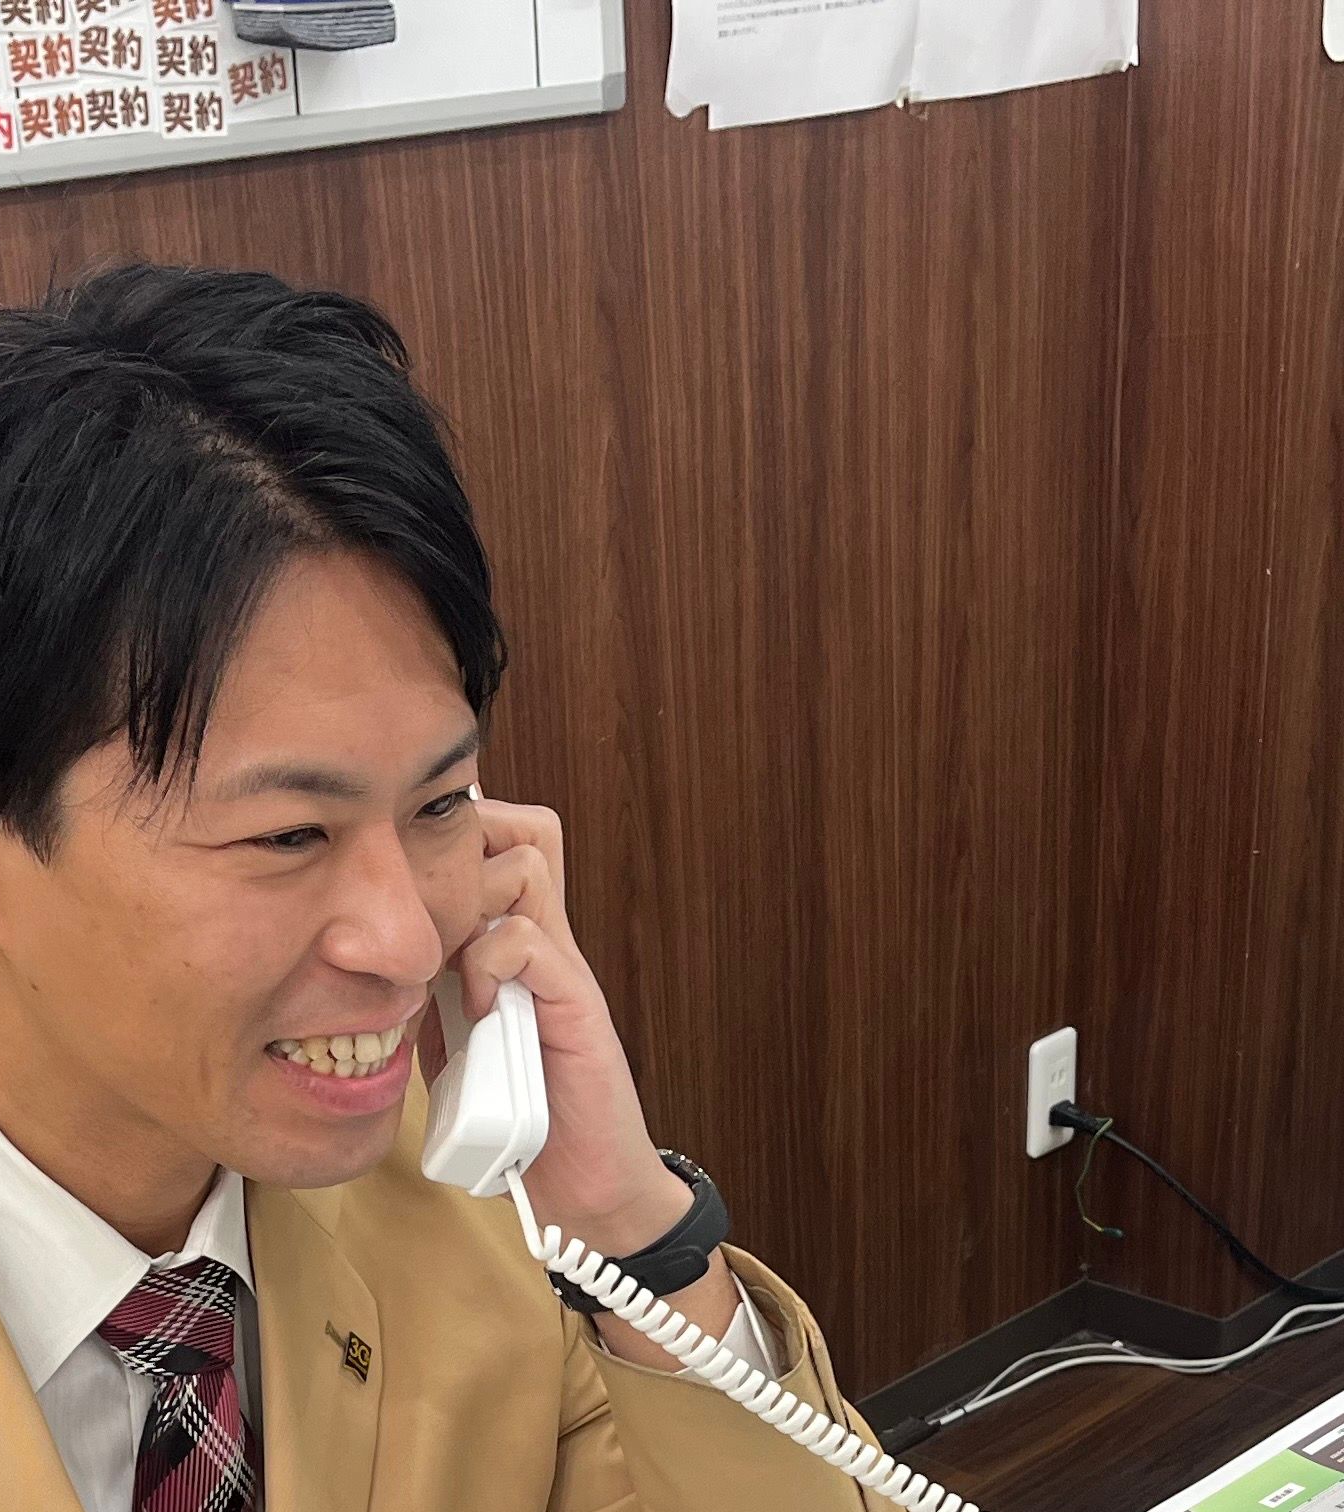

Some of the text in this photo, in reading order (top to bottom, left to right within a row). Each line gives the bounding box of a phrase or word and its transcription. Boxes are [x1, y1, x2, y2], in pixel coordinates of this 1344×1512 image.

[8, 32, 76, 83] 契約
[79, 25, 143, 71] 契約
[157, 34, 218, 77] 契約
[227, 52, 287, 104] 契約
[19, 92, 86, 142] 契約
[85, 86, 150, 131] 契約
[163, 91, 224, 134] 契約
